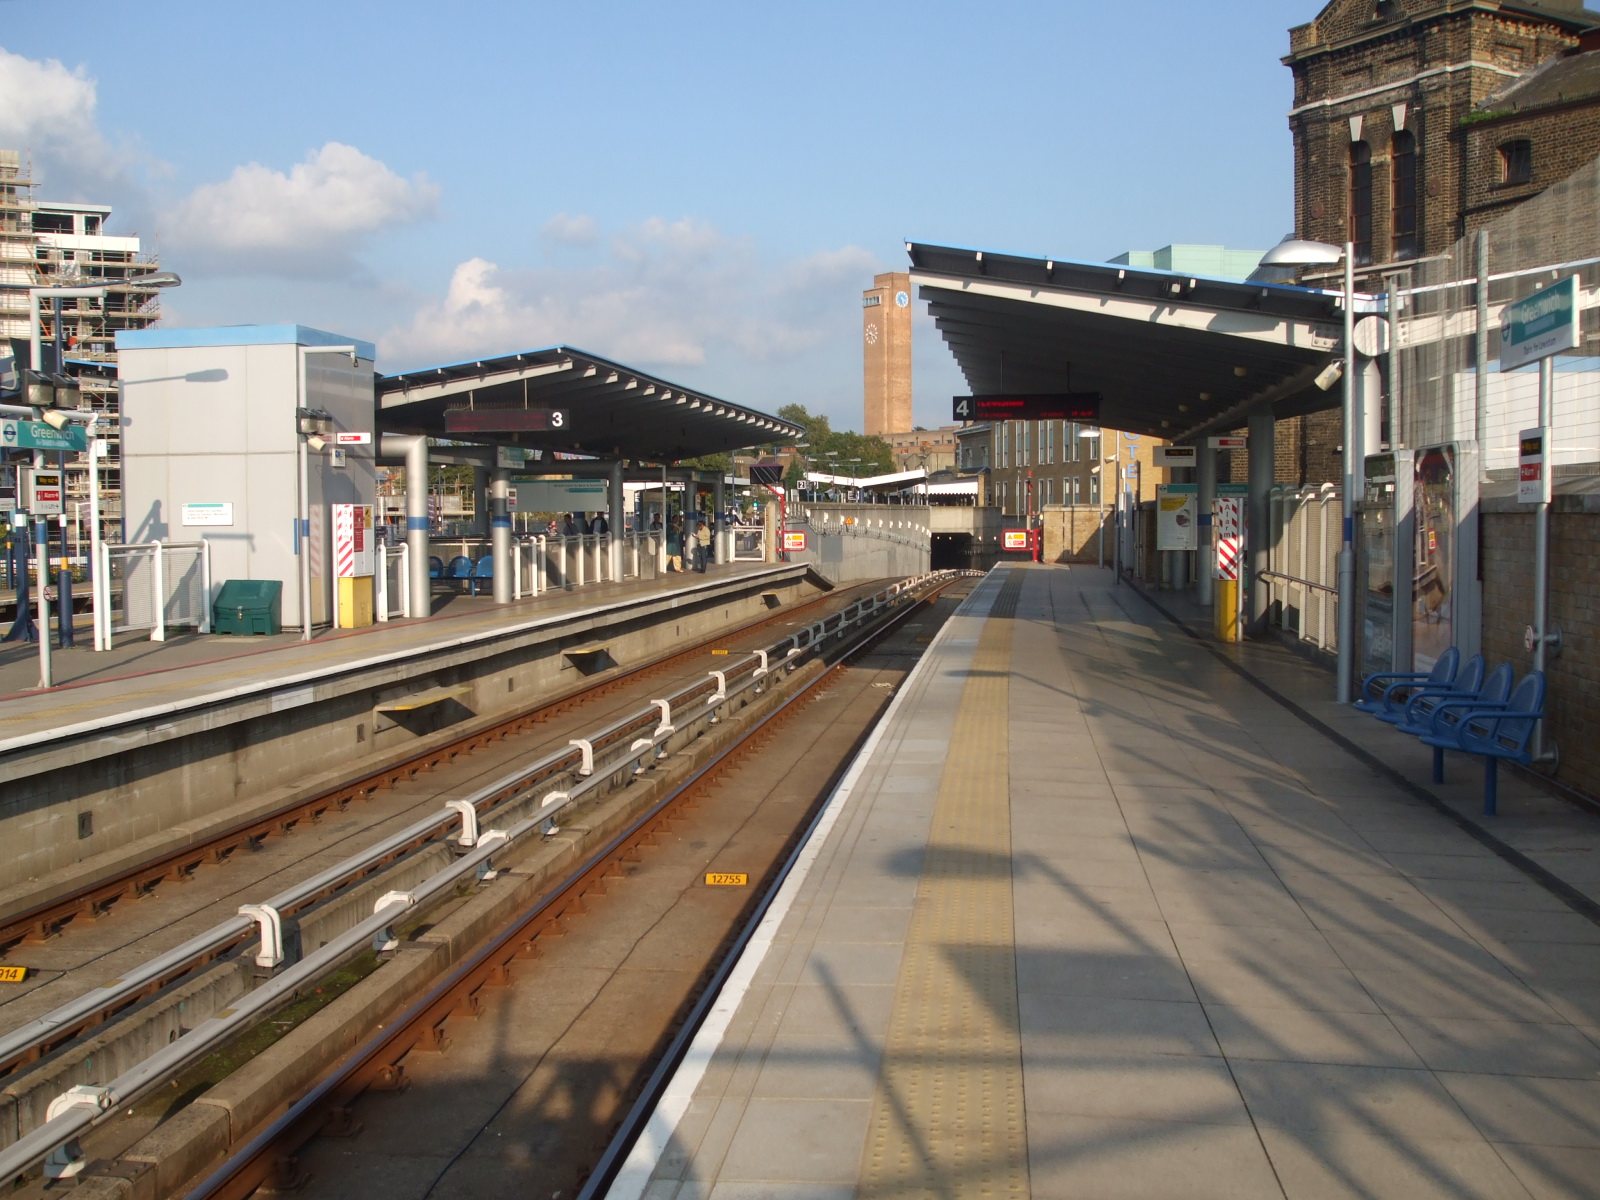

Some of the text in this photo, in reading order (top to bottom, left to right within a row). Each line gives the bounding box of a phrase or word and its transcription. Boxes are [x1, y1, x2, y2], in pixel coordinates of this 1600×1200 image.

[1521, 290, 1560, 325] Greenwich
[955, 400, 970, 416] 4
[551, 411, 564, 427] 3
[30, 424, 75, 441] Greenwich
[1223, 504, 1231, 538] Alarm
[712, 874, 742, 884] 12755
